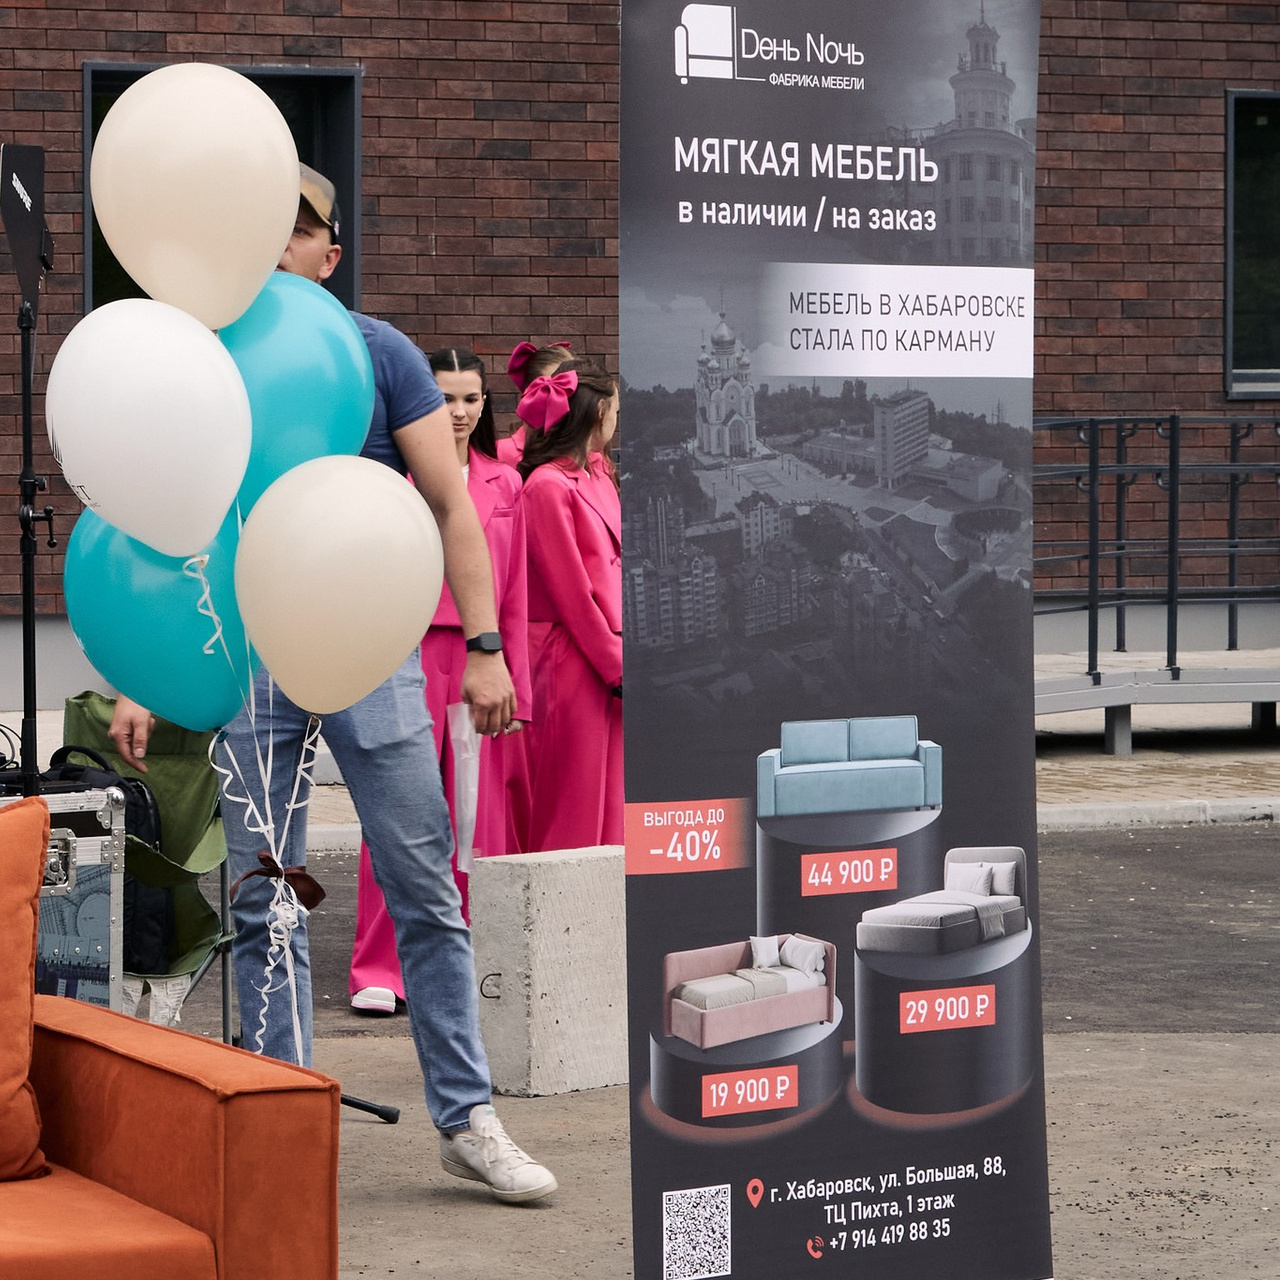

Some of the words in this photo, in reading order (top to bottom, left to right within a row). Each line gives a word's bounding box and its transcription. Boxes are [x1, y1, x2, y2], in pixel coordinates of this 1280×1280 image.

[769, 72, 820, 88] ФАБРИКА
[821, 75, 865, 91] МЕБЕЛИ
[674, 136, 800, 177] МЯГКАЯ
[811, 143, 939, 183] МЕБЕЛЬ
[678, 201, 693, 224] в
[702, 202, 807, 227] наличии
[832, 207, 861, 230] на
[868, 207, 937, 232] заказ
[789, 291, 873, 316] МЕБЕЛЬ
[880, 293, 892, 316] В
[898, 293, 1026, 319] ХАБАРОВСКЕ
[789, 328, 855, 352] СТАЛА
[860, 329, 888, 352] ПО
[894, 329, 996, 353] КАРМАНУ
[643, 809, 704, 827] ВЫГОДА
[706, 808, 725, 825] ДО
[649, 829, 722, 861] -40%
[807, 861, 833, 887] 44
[838, 859, 873, 885] 900
[905, 999, 928, 1025] 29
[934, 996, 971, 1022] 900
[710, 1081, 729, 1108] 19
[734, 1077, 770, 1105] 900
[770, 1187, 783, 1203] г.
[786, 1175, 875, 1202] Хабаровск,
[879, 1173, 902, 1194] ул.
[906, 1163, 979, 1186] Большая,
[983, 1155, 1007, 1177] 88,
[824, 1204, 847, 1226] ТЦ
[851, 1200, 903, 1222] Пихта,
[906, 1194, 914, 1214] 1
[917, 1192, 956, 1213] этаж
[829, 1231, 848, 1251] +7
[851, 1228, 877, 1250] 914
[880, 1223, 905, 1245] 419
[909, 1220, 928, 1241] 88
[933, 1217, 951, 1238] 35
